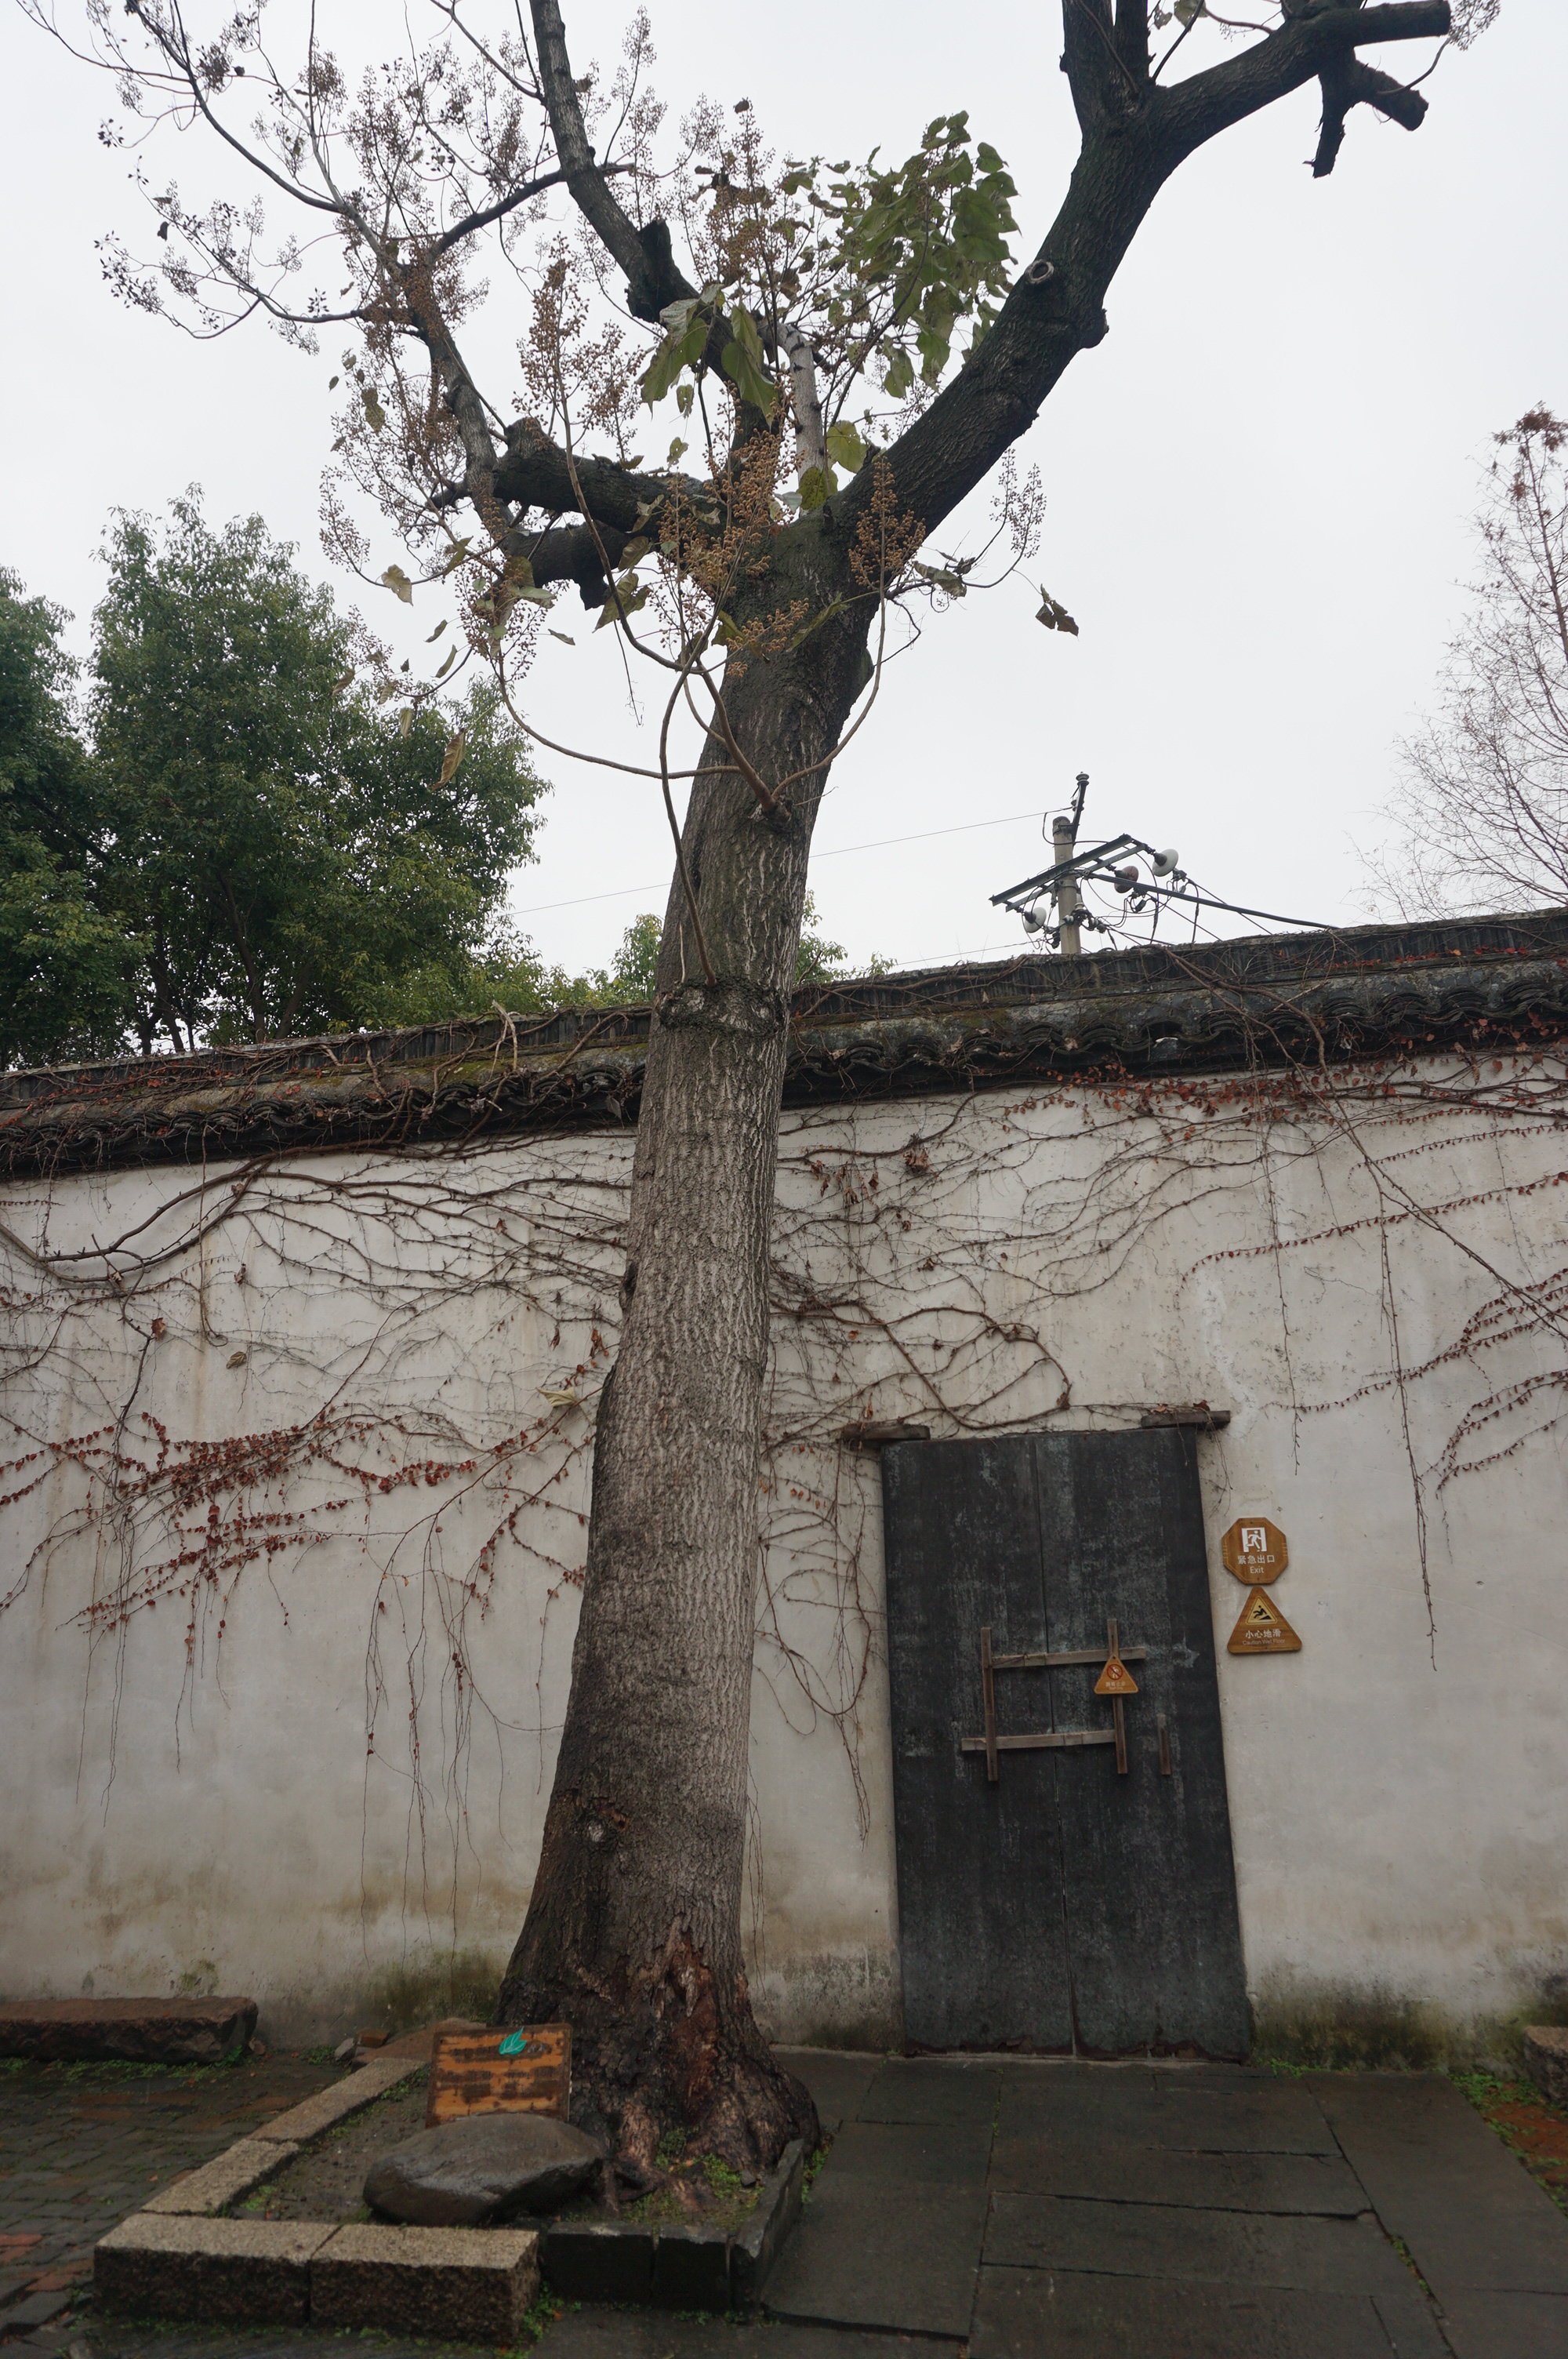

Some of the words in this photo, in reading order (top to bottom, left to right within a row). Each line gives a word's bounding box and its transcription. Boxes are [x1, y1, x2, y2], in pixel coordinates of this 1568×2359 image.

[1238, 1555, 1275, 1565] 紧急出口
[1246, 1629, 1281, 1638] 小心地滑
